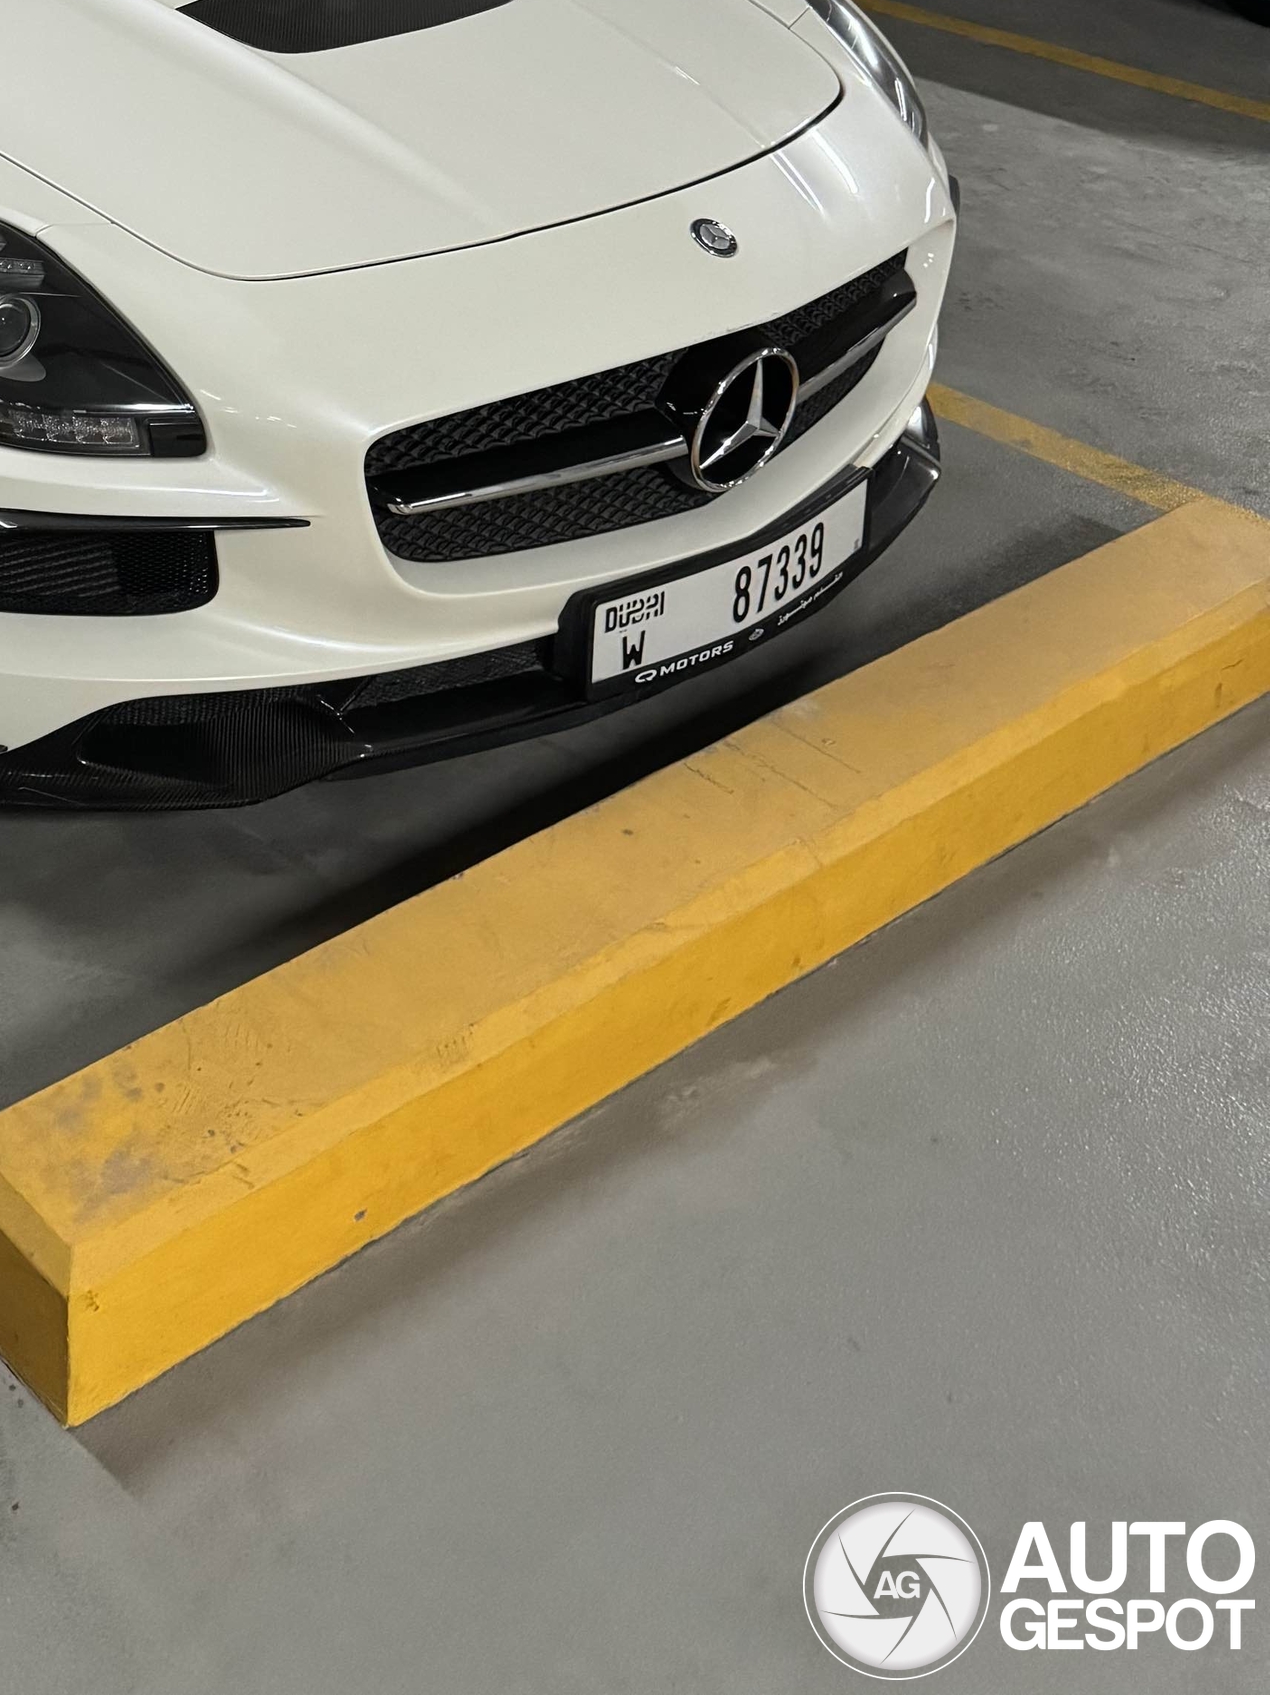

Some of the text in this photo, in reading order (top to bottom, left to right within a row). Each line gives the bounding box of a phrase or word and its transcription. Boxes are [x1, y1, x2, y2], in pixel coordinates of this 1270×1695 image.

[733, 521, 824, 624] 87339
[604, 591, 665, 633] DUBAI
[622, 630, 646, 671] W
[660, 640, 734, 676] MOTORS
